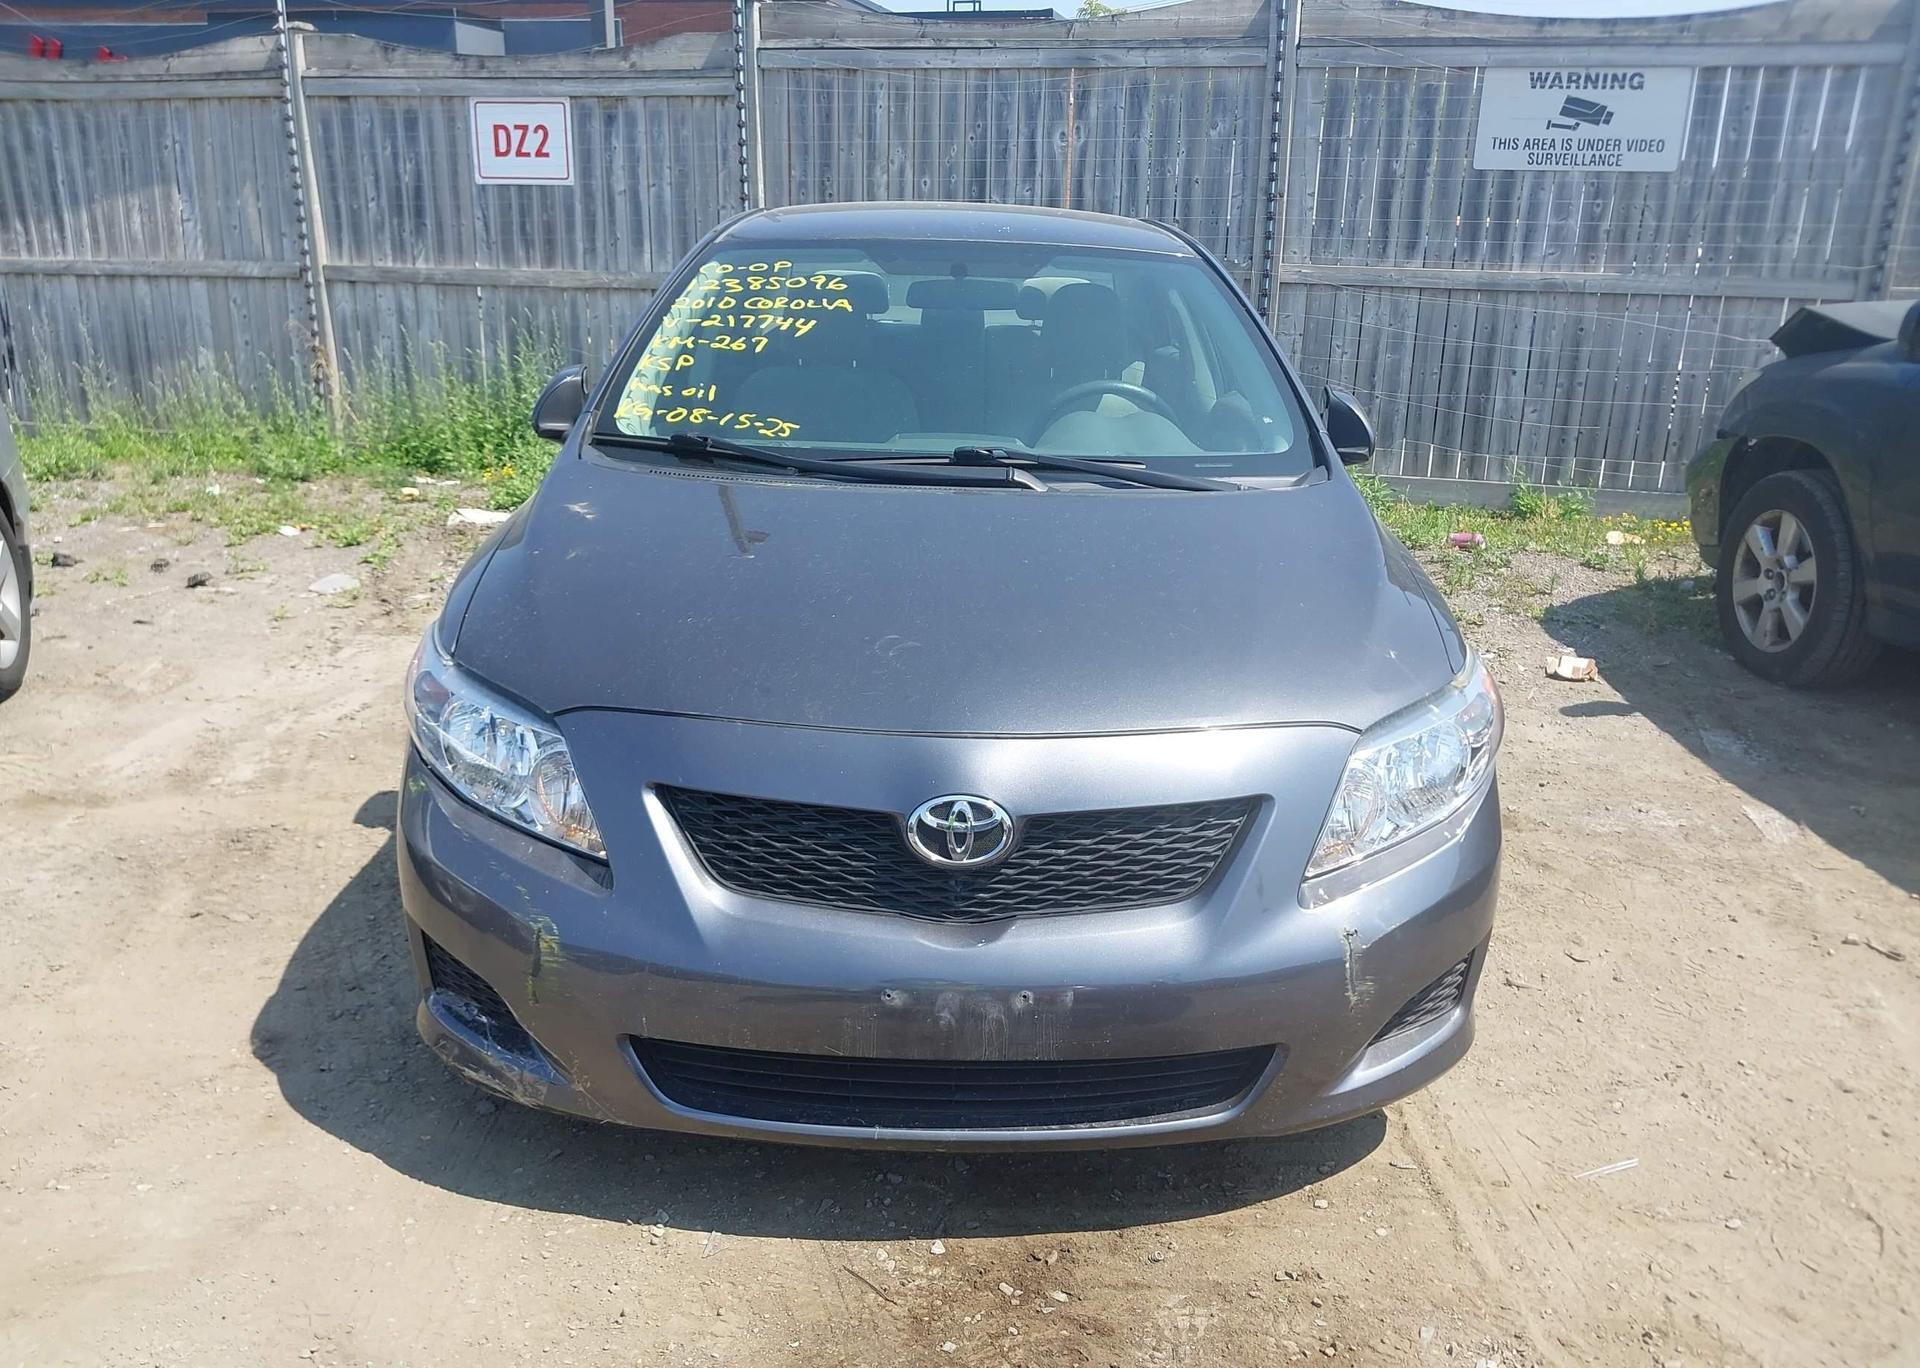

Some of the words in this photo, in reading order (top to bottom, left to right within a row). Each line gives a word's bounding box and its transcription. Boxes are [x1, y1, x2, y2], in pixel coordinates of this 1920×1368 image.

[1529, 71, 1645, 90] WARNING
[492, 123, 550, 158] DZ2
[1491, 136, 1519, 151] THIS
[1522, 137, 1556, 152] AREA
[1560, 138, 1573, 152] IS
[1577, 138, 1622, 152] UNDER
[1626, 138, 1666, 153] VIDEO
[1526, 151, 1624, 167] SURVEILLANCE
